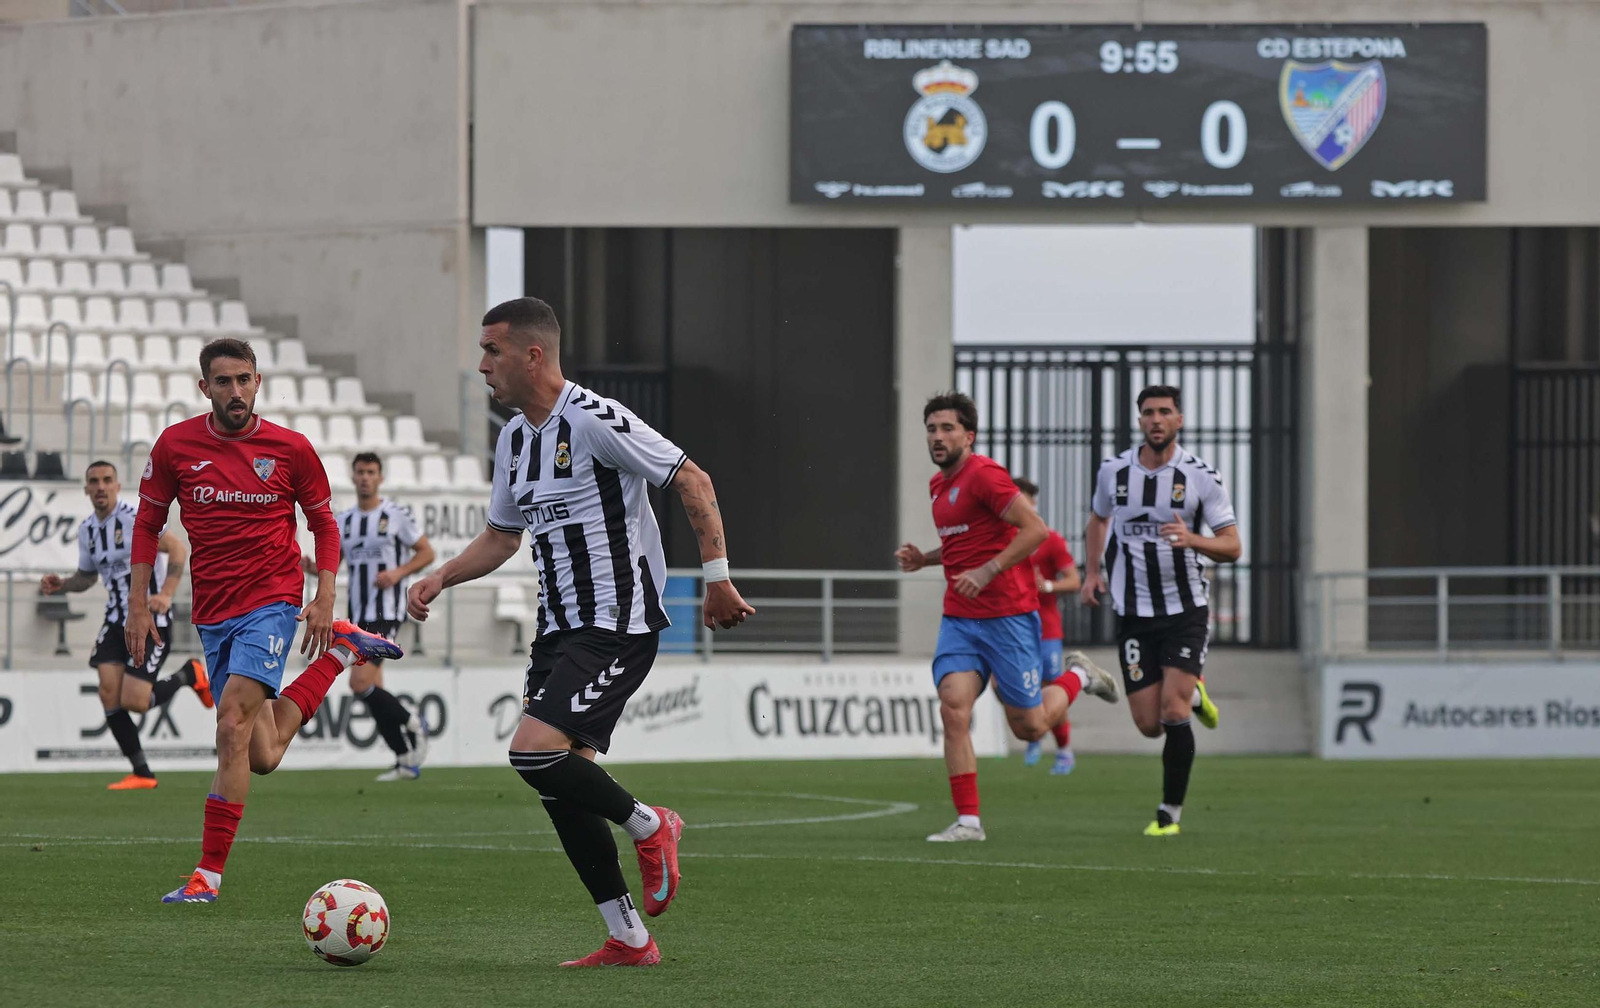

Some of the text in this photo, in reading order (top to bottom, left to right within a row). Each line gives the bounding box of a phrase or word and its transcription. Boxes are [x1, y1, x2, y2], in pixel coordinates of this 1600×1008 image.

[985, 38, 1031, 59] SAD
[1100, 40, 1179, 74] 9:55
[1257, 37, 1407, 58] CD ESTEPONA
[1029, 100, 1077, 170] 0
[1201, 99, 1248, 169] 0
[215, 489, 279, 505] AirEuropa
[521, 502, 570, 525] OTUS
[268, 634, 285, 658] 14
[1124, 638, 1141, 665] 6
[1022, 668, 1039, 690] 28
[748, 681, 976, 745] Cruzcamp
[1404, 703, 1538, 728] Autocares
